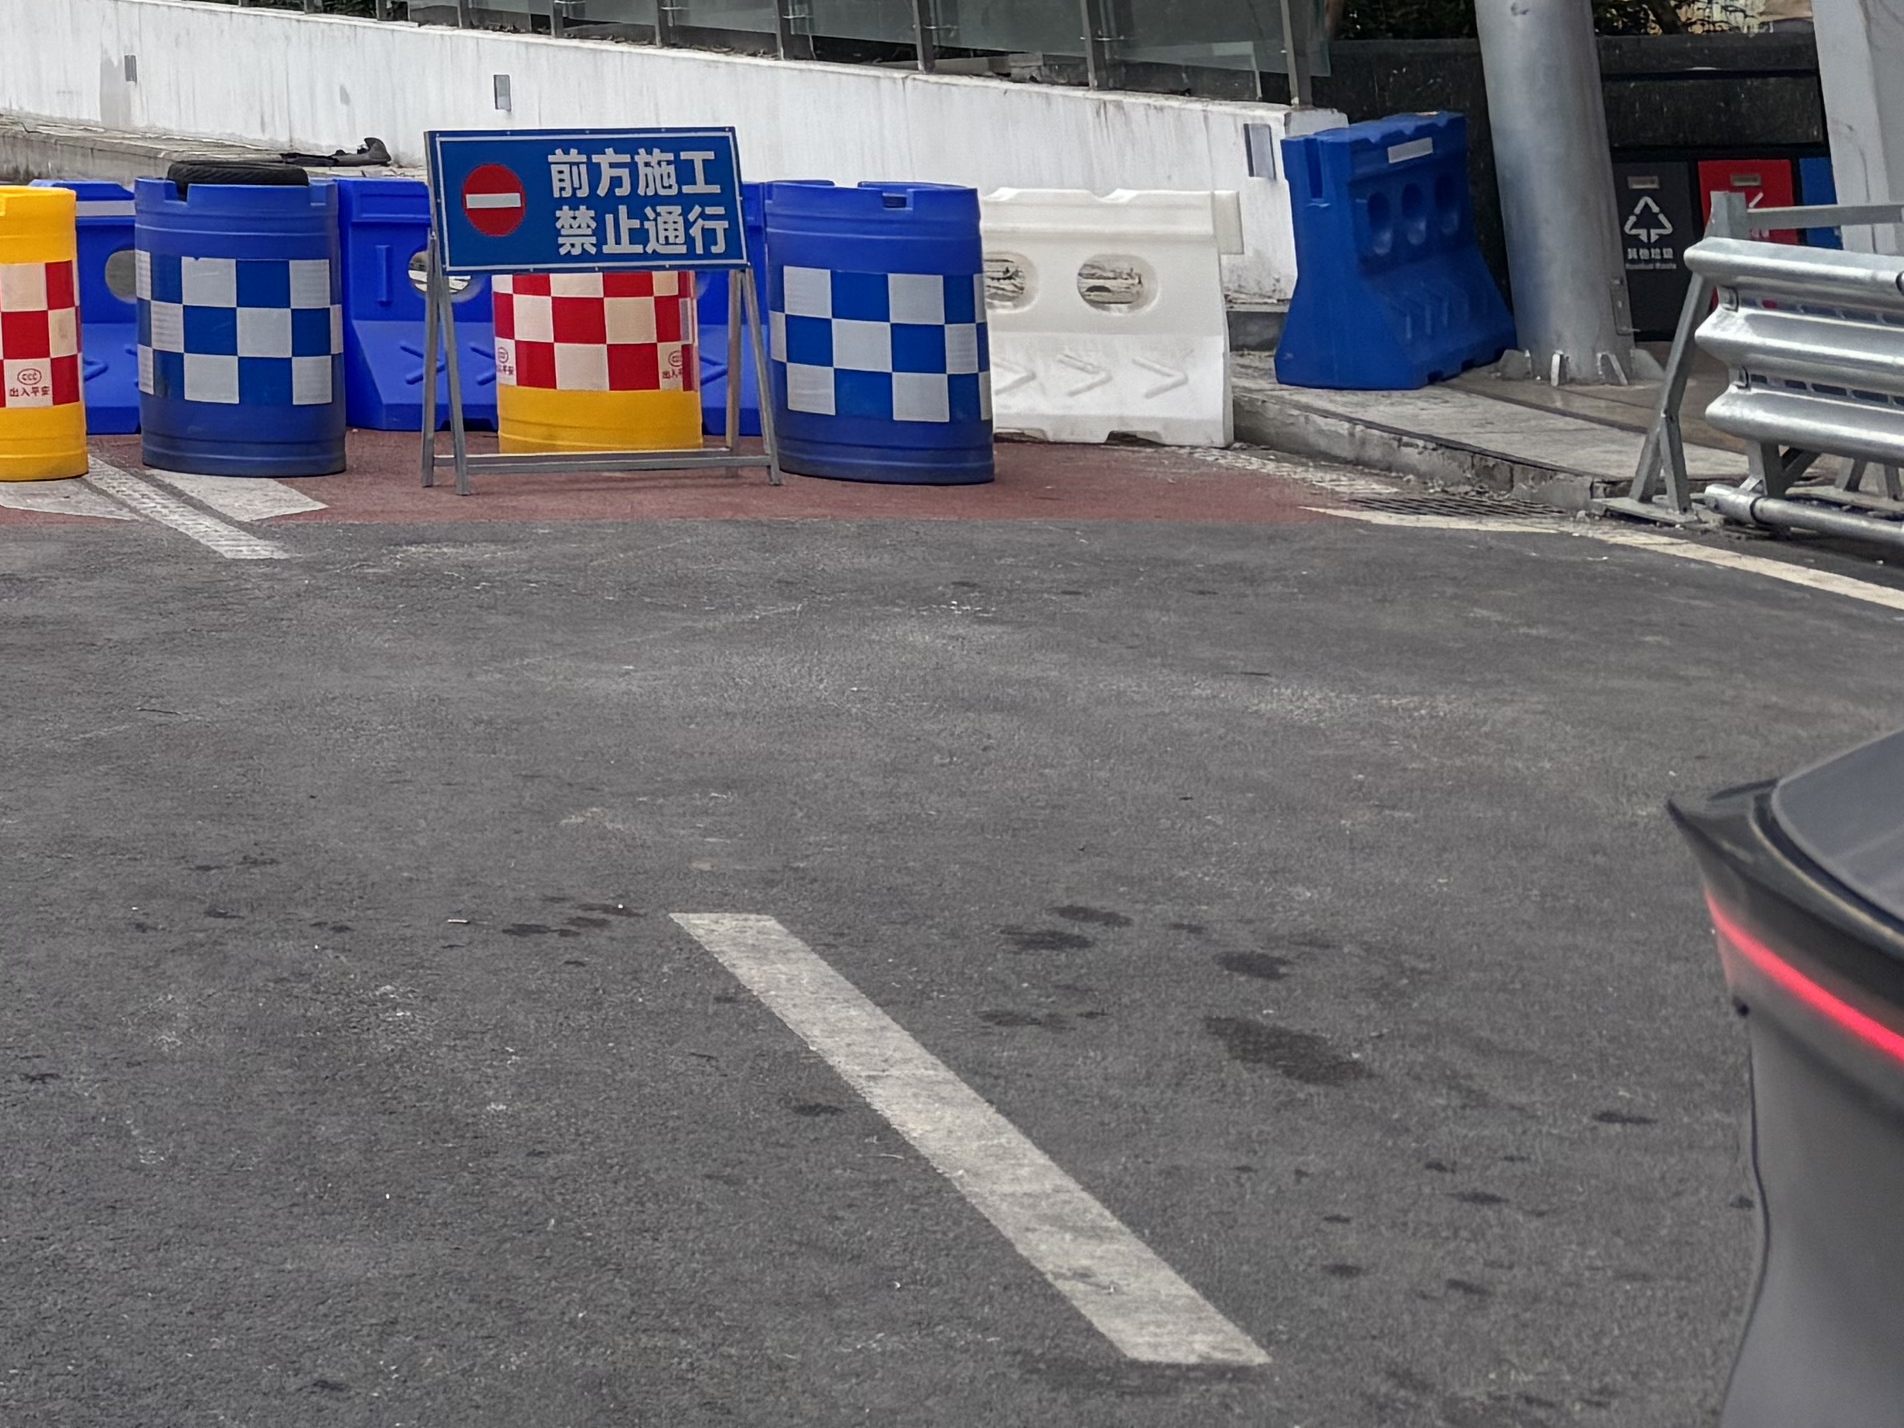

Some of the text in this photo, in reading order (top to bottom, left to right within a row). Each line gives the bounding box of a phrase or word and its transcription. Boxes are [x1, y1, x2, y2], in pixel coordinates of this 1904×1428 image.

[547, 147, 722, 199] 前方施工
[554, 204, 729, 257] 禁止通行
